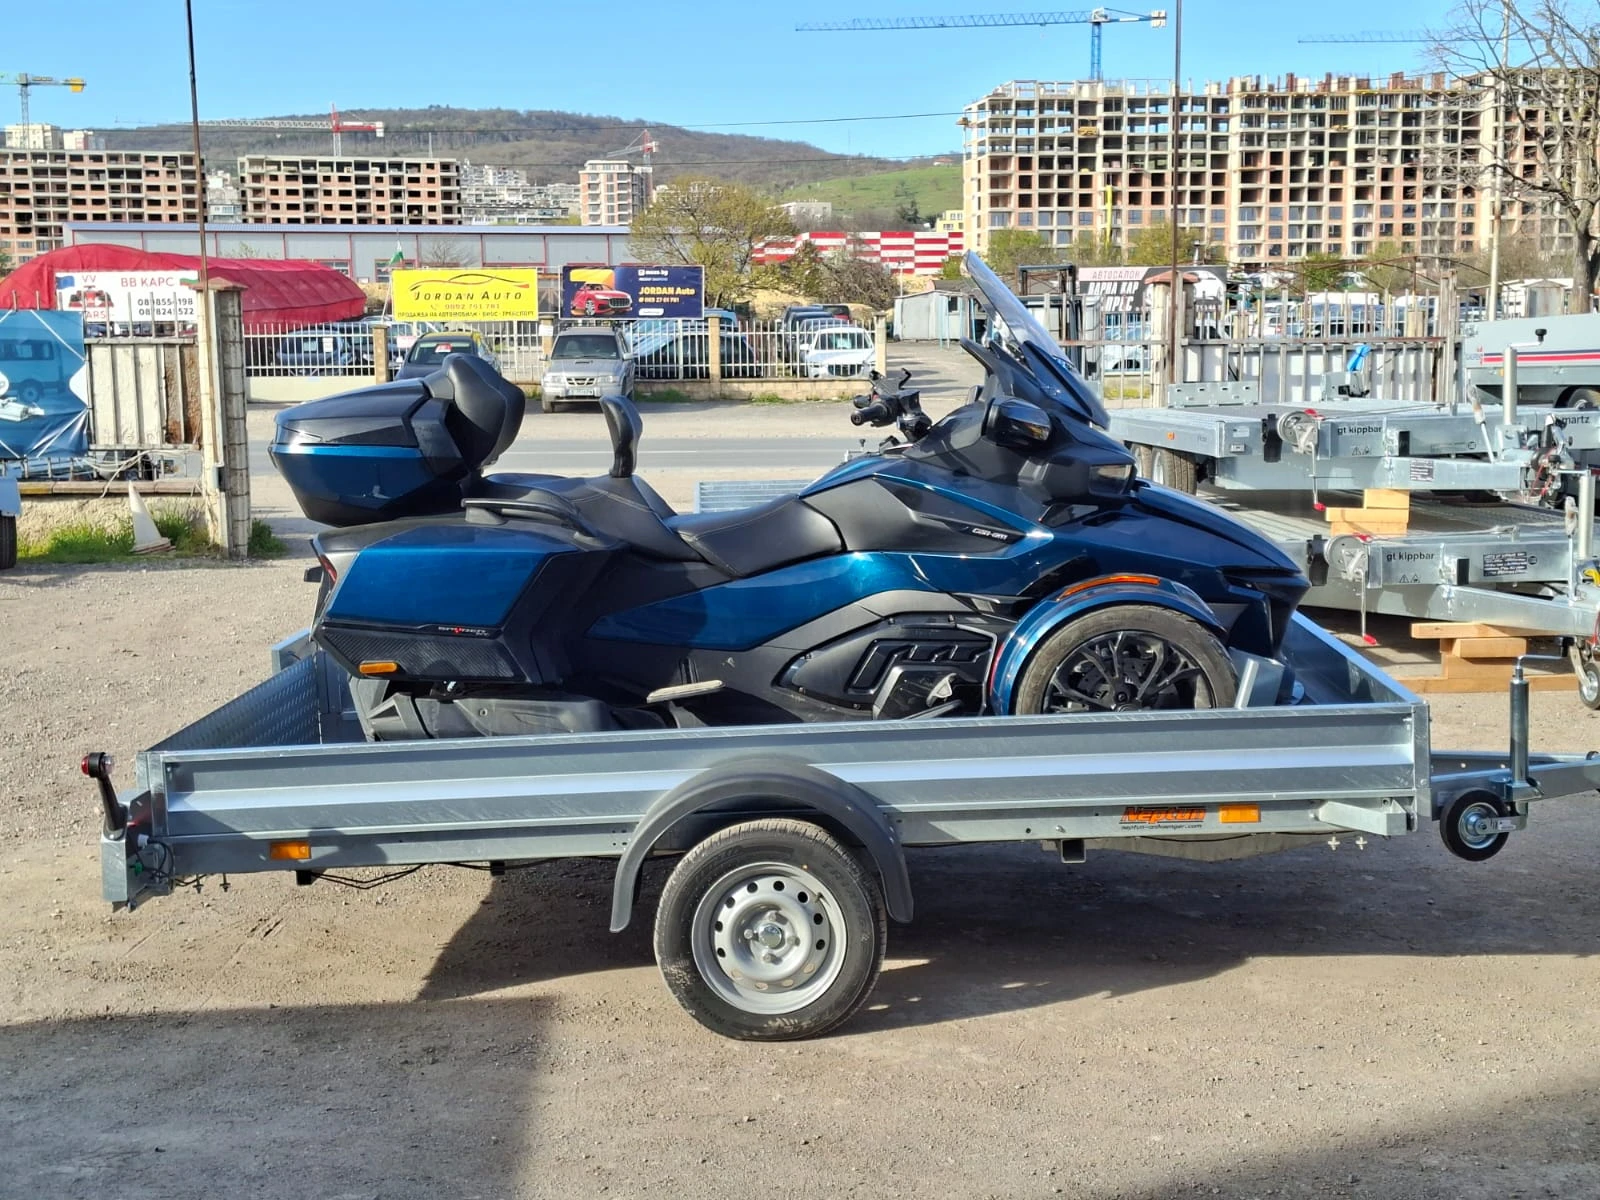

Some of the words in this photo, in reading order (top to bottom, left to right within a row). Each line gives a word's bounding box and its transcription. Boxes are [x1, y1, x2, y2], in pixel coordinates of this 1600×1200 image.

[82, 275, 96, 283] VV
[1091, 271, 1141, 279] АВТОСАЛОН
[141, 277, 175, 287] КАРС
[639, 287, 674, 295] JORDAN
[675, 287, 695, 295] Auto
[415, 291, 475, 301] JORDAN
[83, 311, 106, 319] ARS
[138, 307, 195, 316] 08824522
[1560, 416, 1590, 424] martz
[1337, 425, 1346, 435] gt
[1349, 425, 1382, 435] kippbar
[1386, 552, 1396, 561] gt
[1399, 551, 1434, 562] kippbar
[1120, 806, 1207, 824] Neptun
